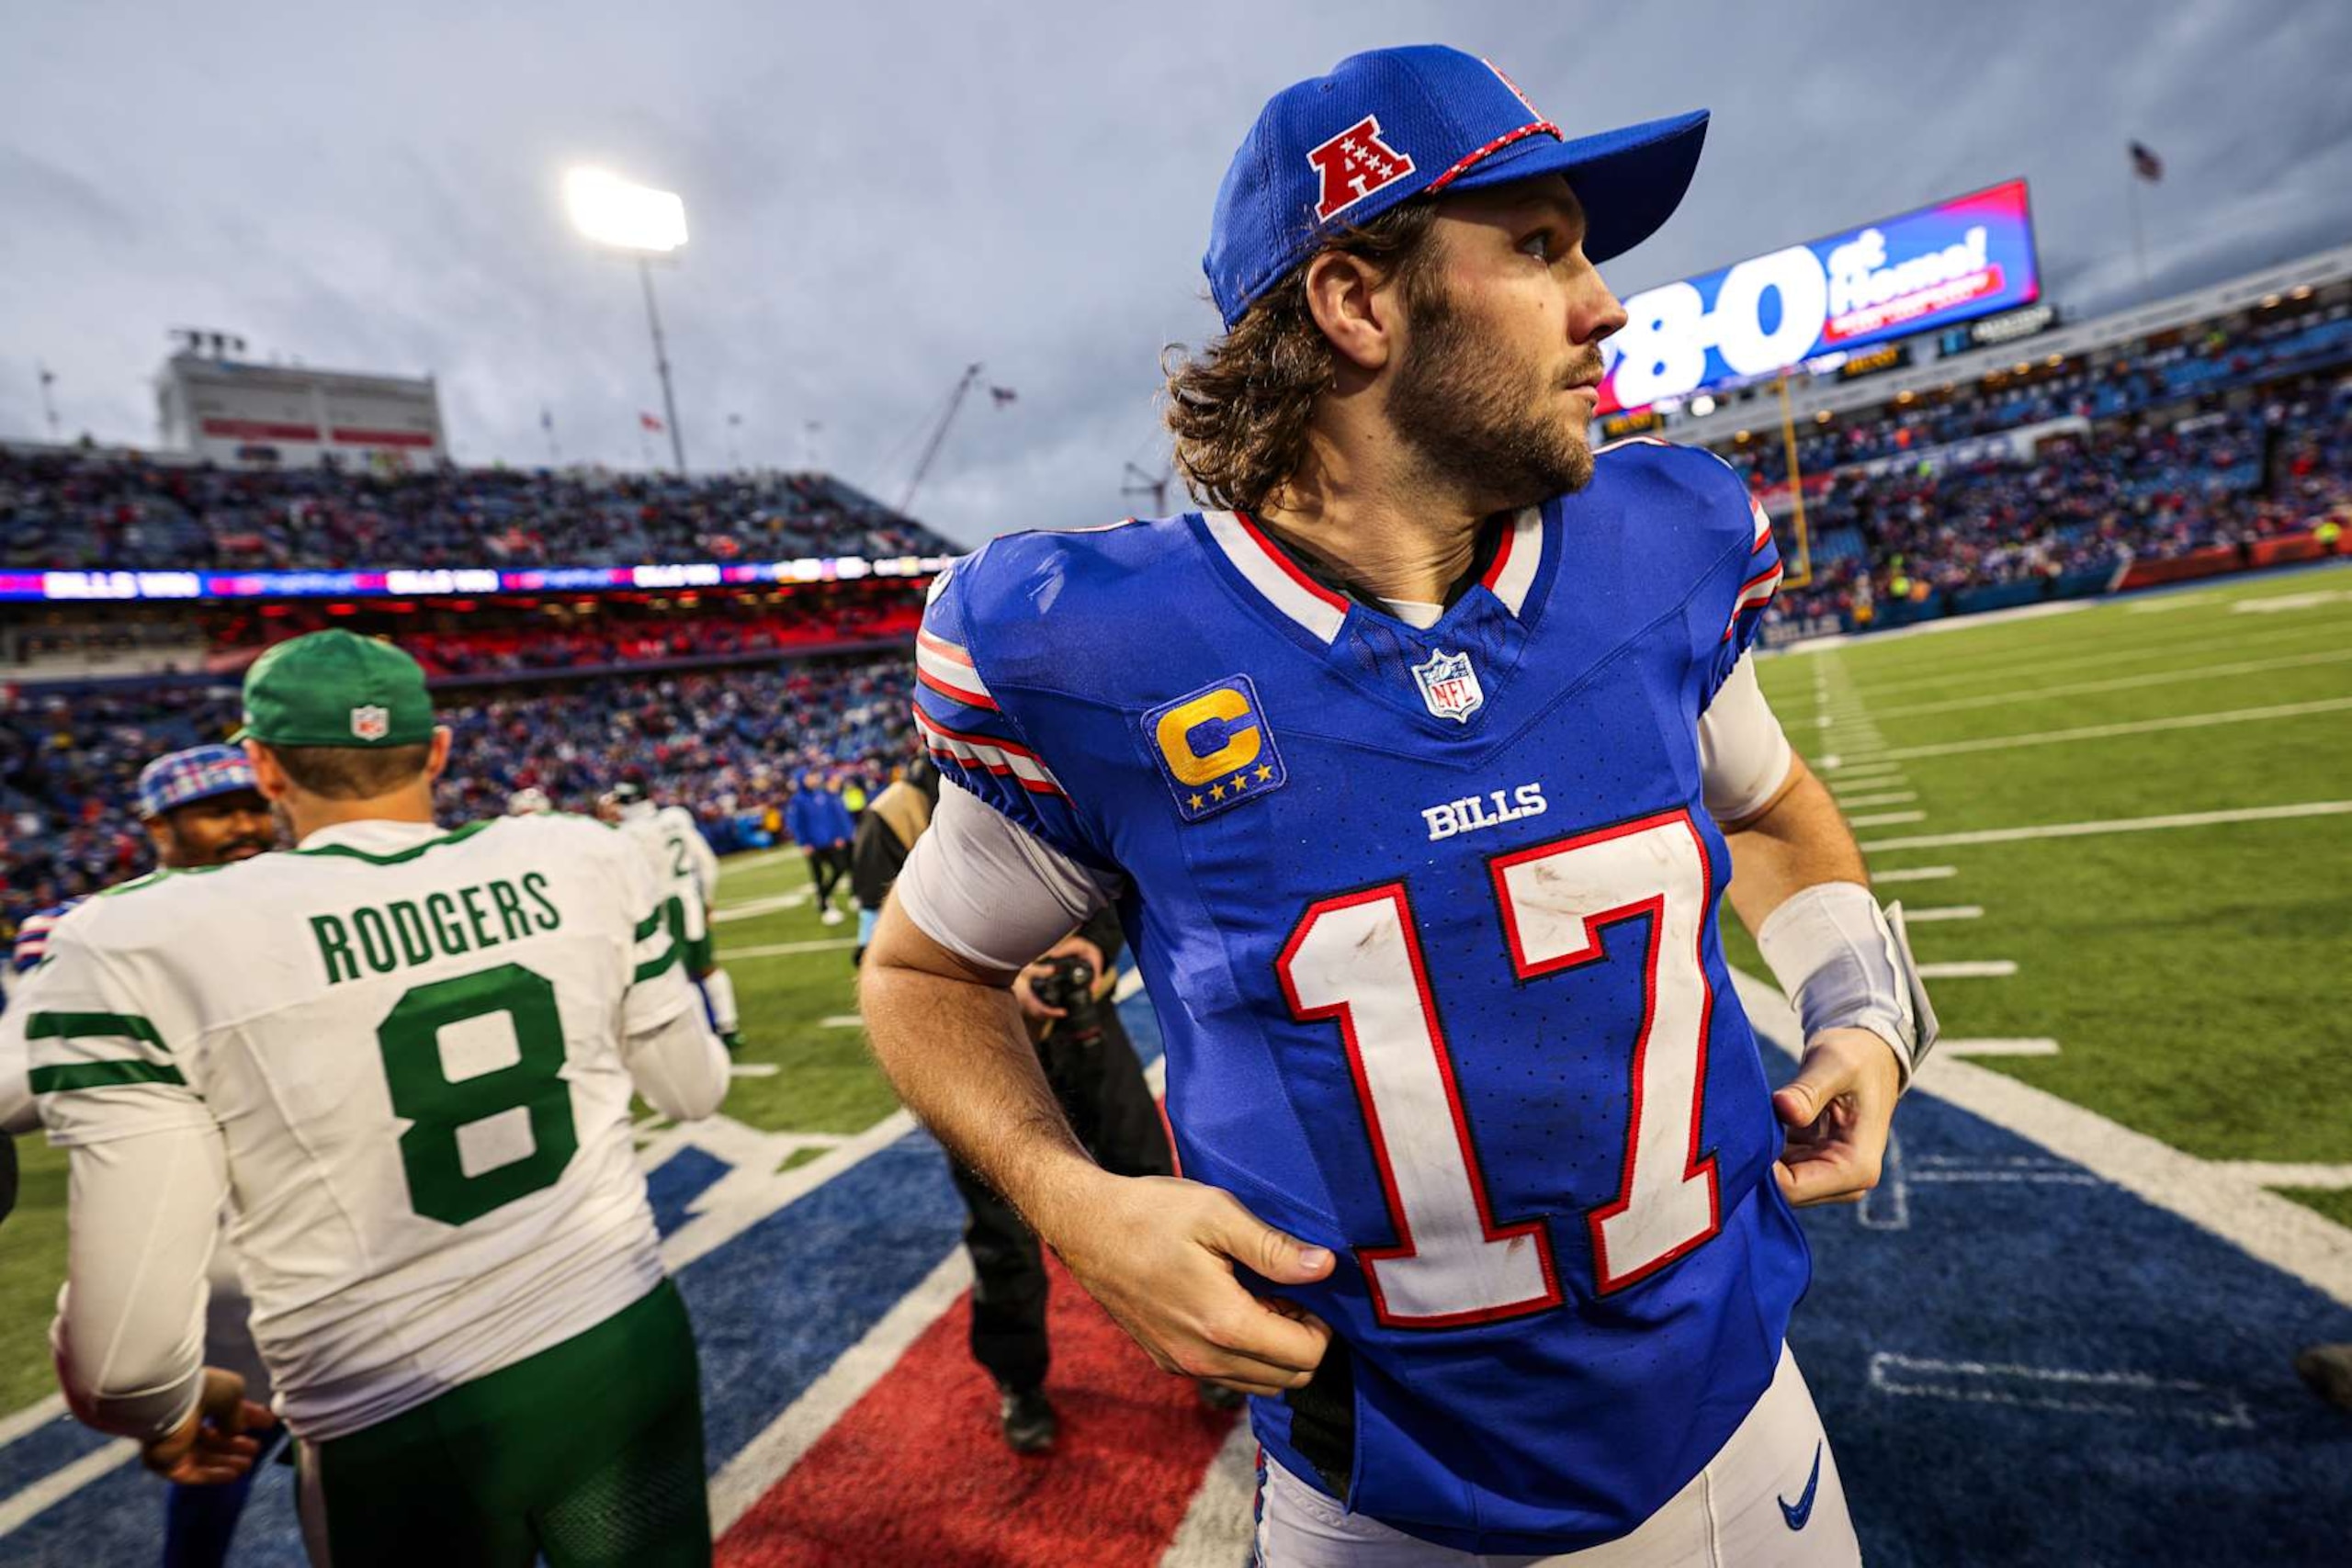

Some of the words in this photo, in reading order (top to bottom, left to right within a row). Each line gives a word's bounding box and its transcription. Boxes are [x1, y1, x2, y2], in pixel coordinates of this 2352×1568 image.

[1306, 114, 1417, 224] A
[1156, 688, 1261, 787] C
[1430, 679, 1475, 708] NFL
[1420, 782, 1548, 841] BILLS
[309, 872, 562, 986] RODGERS
[376, 961, 580, 1227] 8
[1275, 807, 1721, 1330] 17
